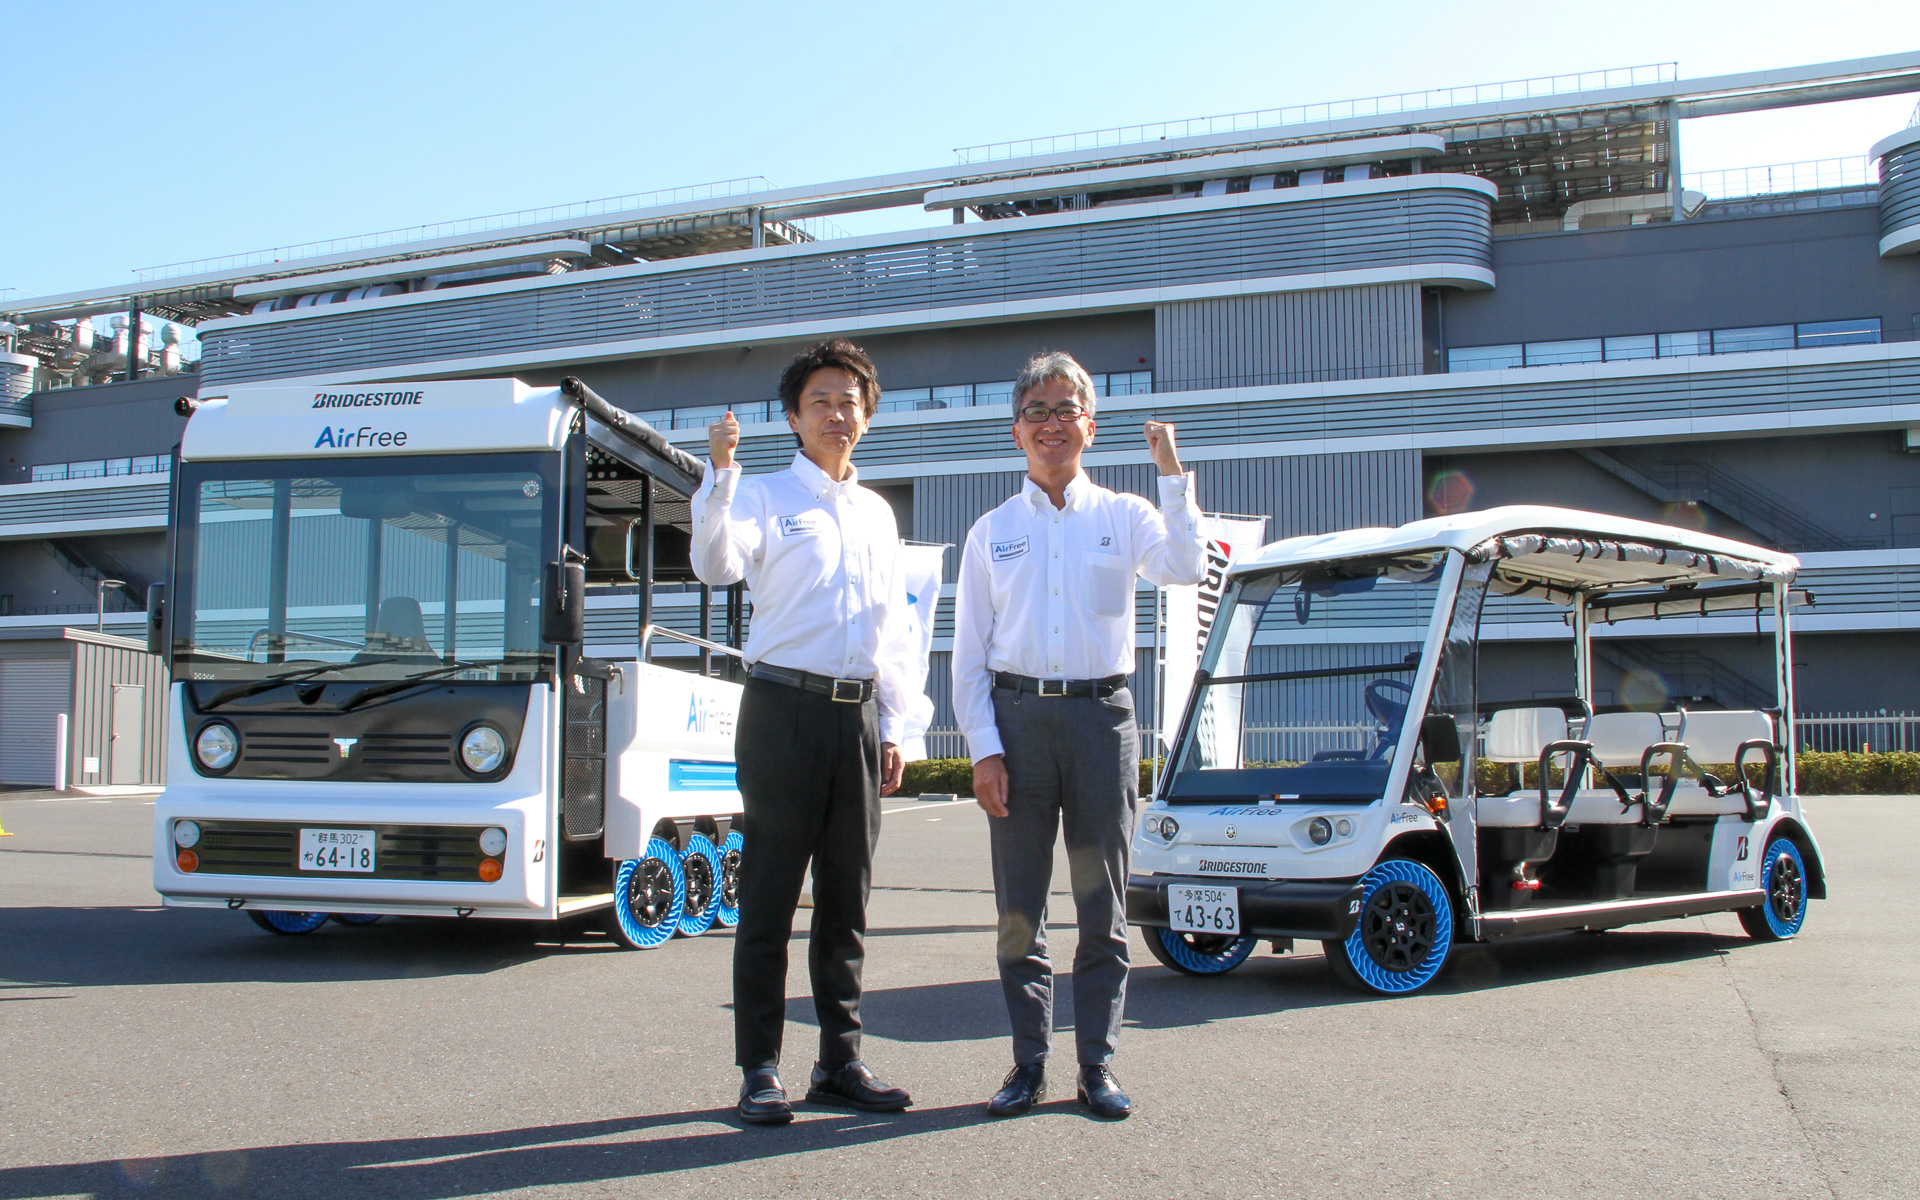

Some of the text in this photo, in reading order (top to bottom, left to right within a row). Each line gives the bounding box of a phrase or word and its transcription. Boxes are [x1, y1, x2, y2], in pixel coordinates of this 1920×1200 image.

[312, 391, 424, 408] BRIDGESTONE
[314, 426, 408, 448] AirFree
[995, 541, 1027, 553] AirFree
[687, 691, 732, 735] AirFree
[1208, 806, 1282, 816] AirFree
[1390, 812, 1418, 824] AirFree
[315, 846, 371, 868] 64-18
[1199, 860, 1267, 874] BRIDGESTONE
[1733, 871, 1755, 882] AirFree
[1184, 904, 1235, 930] 43-63
